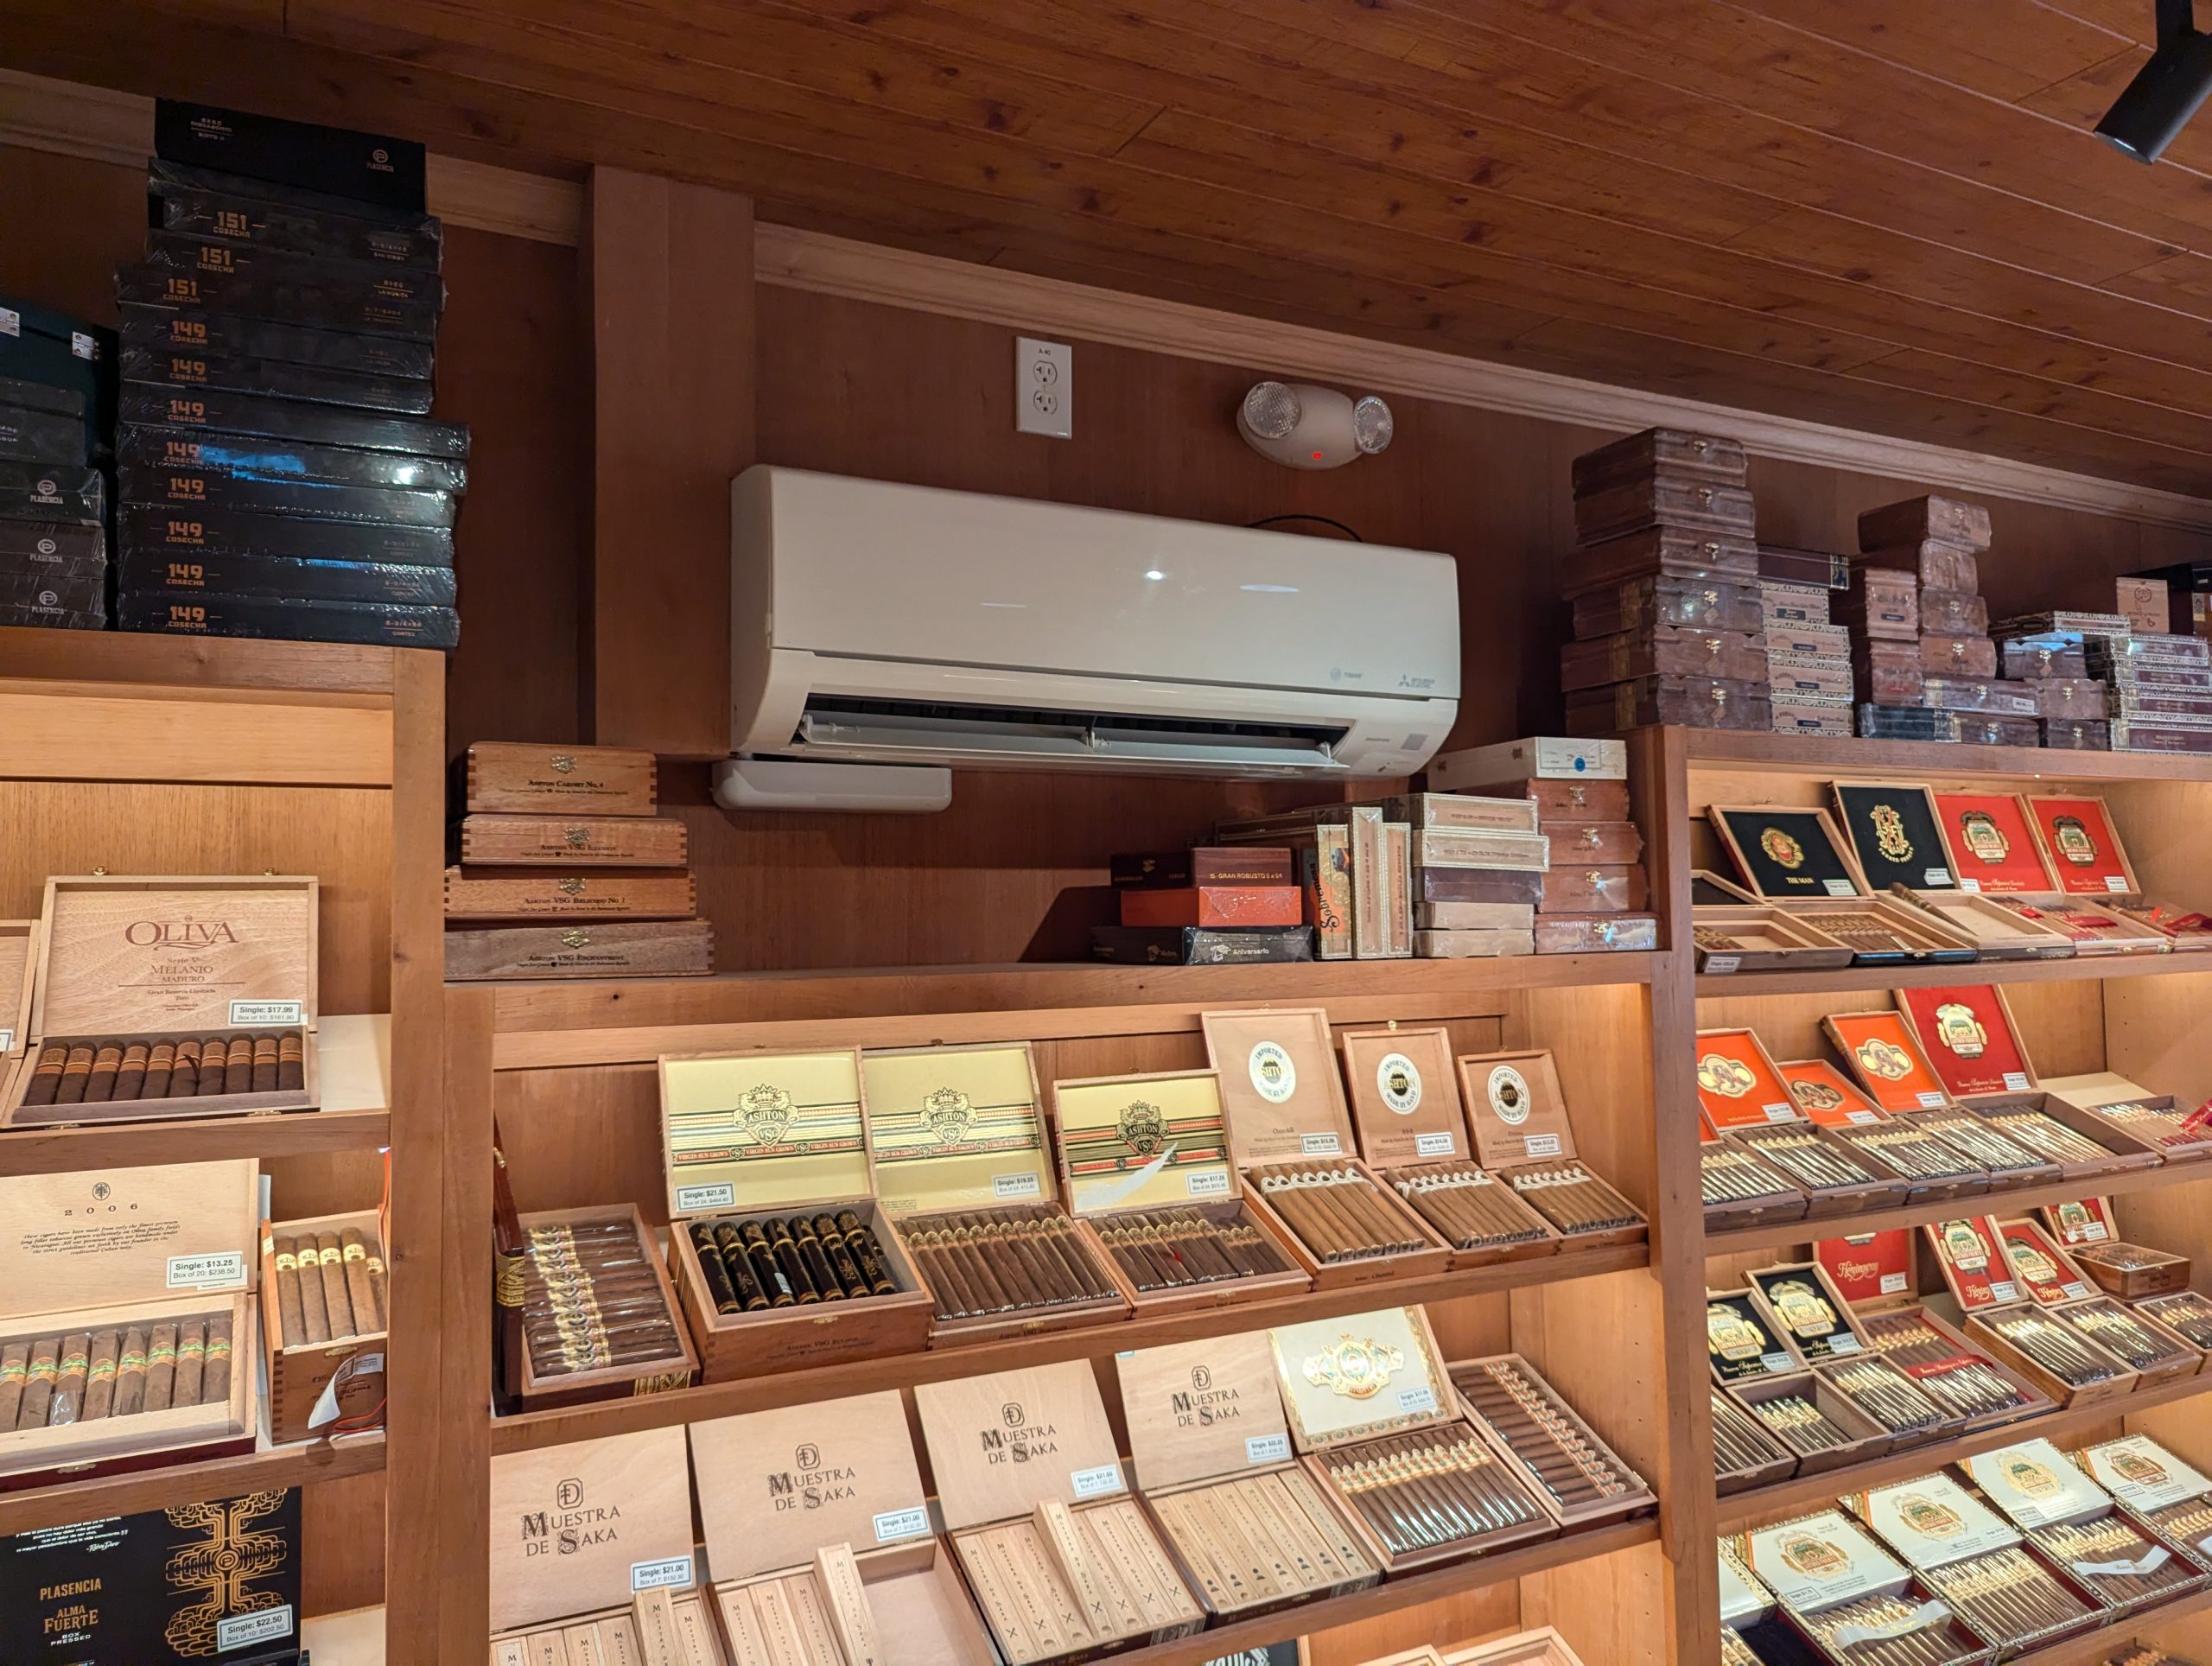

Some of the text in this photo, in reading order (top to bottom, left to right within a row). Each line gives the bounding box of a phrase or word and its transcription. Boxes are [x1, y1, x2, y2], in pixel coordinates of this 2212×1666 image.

[217, 212, 246, 229] 151
[213, 226, 251, 238] COSECHA
[201, 247, 231, 265] 151
[197, 263, 234, 273] COSECHA
[168, 279, 197, 296] 151
[163, 294, 200, 303] COSECHA
[172, 321, 207, 338] 149
[172, 359, 206, 375] 149
[169, 372, 207, 383] COSECHA
[170, 400, 205, 416] 149
[168, 414, 207, 424] COSECHA
[166, 442, 200, 457] 149
[163, 454, 202, 464] COSECHA
[169, 479, 203, 493] 149
[30, 494, 63, 505] PLASENCIA
[168, 491, 206, 501] COSECHA
[168, 522, 202, 537] 149
[166, 534, 205, 545] COSECHA
[30, 552, 62, 563] PLASENCIA
[168, 564, 203, 579] 149
[166, 576, 205, 587] COSECHA
[32, 603, 65, 614] PLASENCIA
[169, 607, 205, 621] 149
[168, 619, 207, 629] COSECHA
[151, 964, 214, 975] MELANIO
[1255, 1046, 1283, 1060] IMPORTED
[1383, 1059, 1410, 1072] IMPORTED
[1383, 1078, 1416, 1090] ASHTON
[1494, 1071, 1517, 1084] IMPORTED
[1386, 1092, 1400, 1108] MADE
[1406, 1090, 1417, 1106] HAND
[1495, 1087, 1525, 1102] ASHTON
[747, 1110, 785, 1122] ASHTON
[1498, 1103, 1511, 1117] MADE
[933, 1112, 966, 1123] ASHTON
[759, 1129, 779, 1141] VSG
[944, 1128, 960, 1140] VSG
[1128, 1124, 1159, 1135] ASHTON
[730, 1147, 745, 1160] VSG
[795, 1142, 810, 1154] VSG
[1137, 1140, 1154, 1152] VSG
[998, 1179, 1016, 1187] Single:
[684, 1188, 727, 1199] Single: $21.50
[175, 1259, 233, 1271] Single: $13.25
[196, 1269, 207, 1278] 20:
[208, 1267, 236, 1276] $238.50
[1171, 1388, 1240, 1415] MUESTRA
[1177, 1405, 1241, 1428] DE SAKA
[980, 1424, 1057, 1452] MUESTRA
[988, 1441, 1058, 1465] DE SAKA
[767, 1466, 856, 1497] MUESTRA
[1077, 1476, 1096, 1485] Single:
[775, 1485, 856, 1511] DE SAKA
[521, 1505, 621, 1541] MUESTRA
[882, 1514, 920, 1528] Single: $21.00
[526, 1527, 619, 1557] DE SAKA
[639, 1564, 684, 1579] Single: $21.00
[40, 1578, 103, 1601] PLASENCIA
[56, 1606, 86, 1618] ALMA
[43, 1609, 99, 1634] FUERTE
[227, 1615, 283, 1636] Single: $22.50
[259, 1625, 284, 1635] $202.50
[50, 1633, 92, 1646] PRESSED
